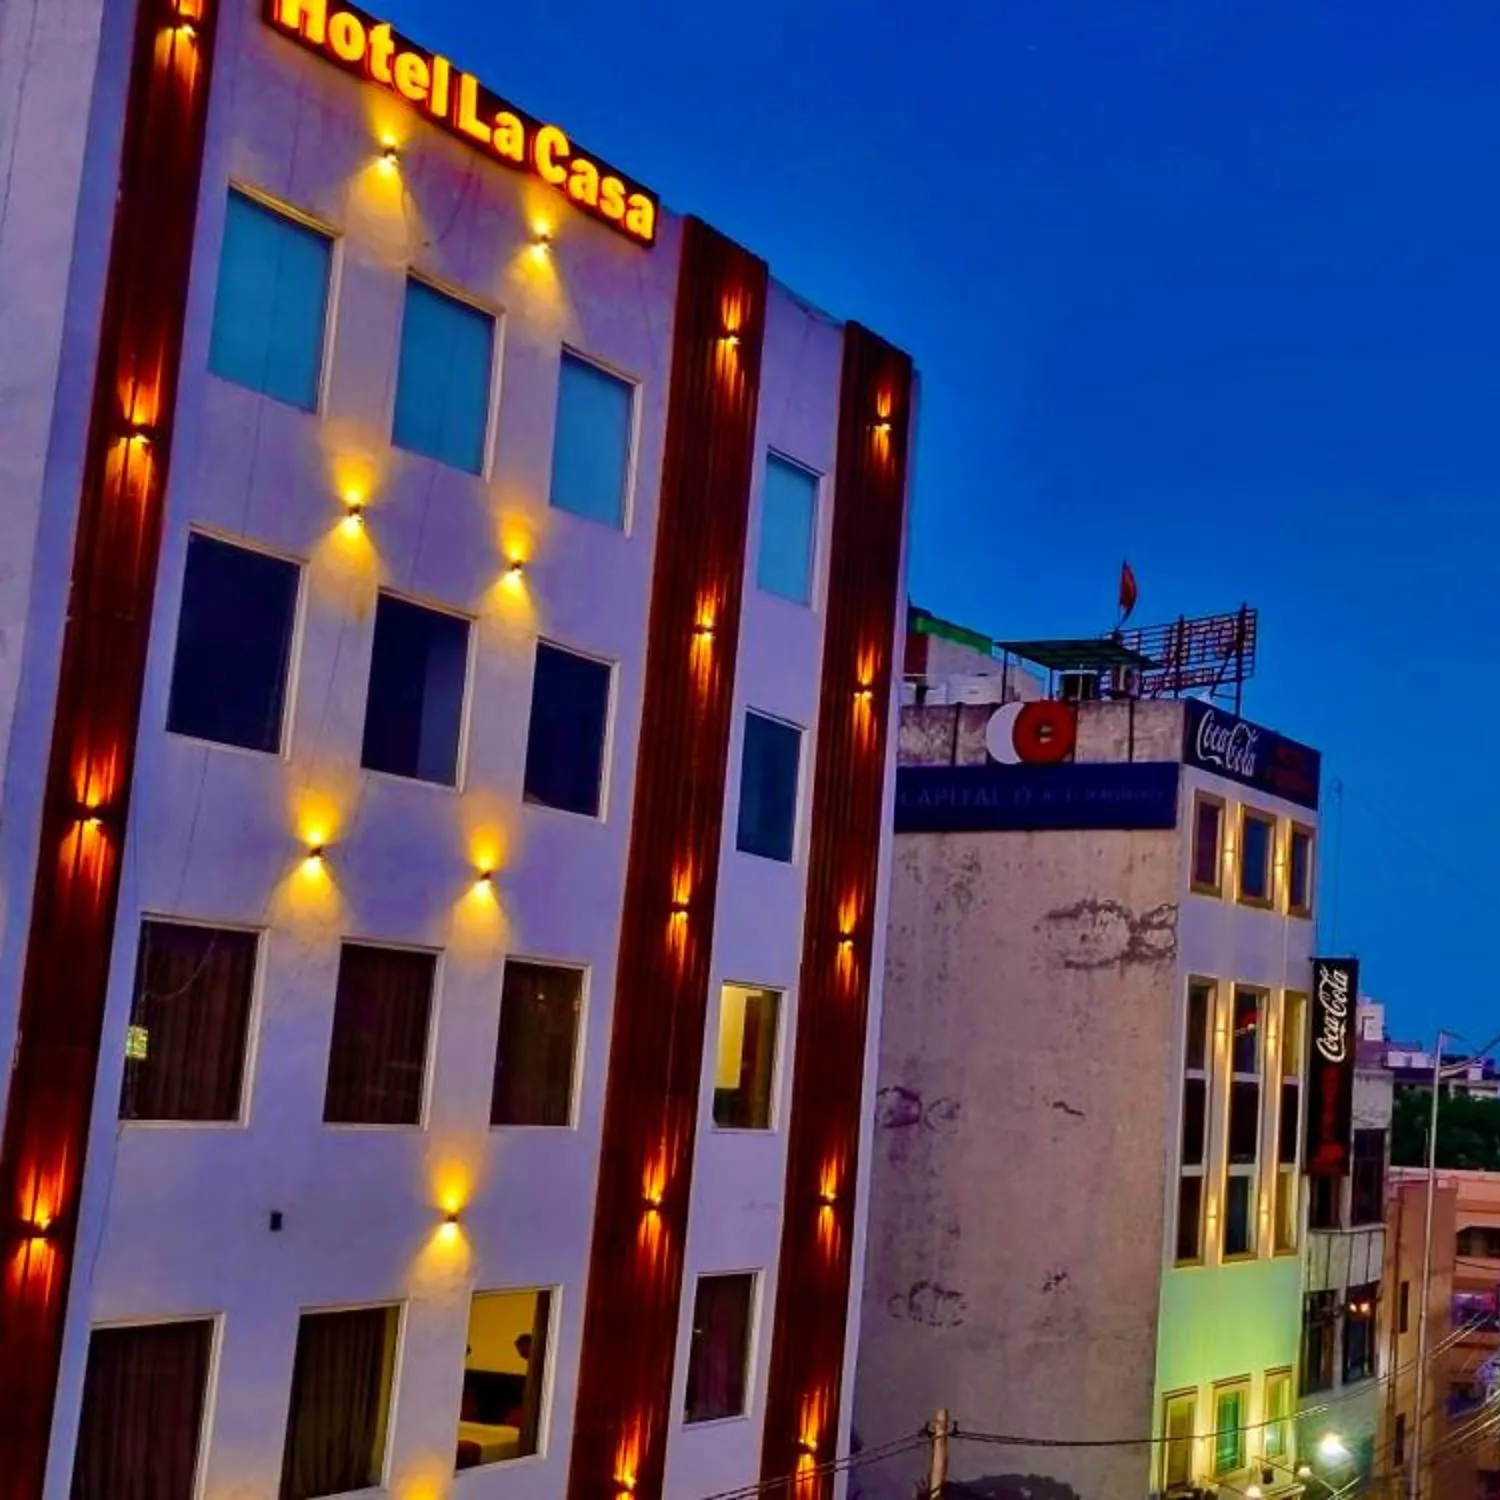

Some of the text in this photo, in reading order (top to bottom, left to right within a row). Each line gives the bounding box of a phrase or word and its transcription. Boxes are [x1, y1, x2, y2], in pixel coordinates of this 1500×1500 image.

[278, 0, 656, 241] Hotel La Casa
